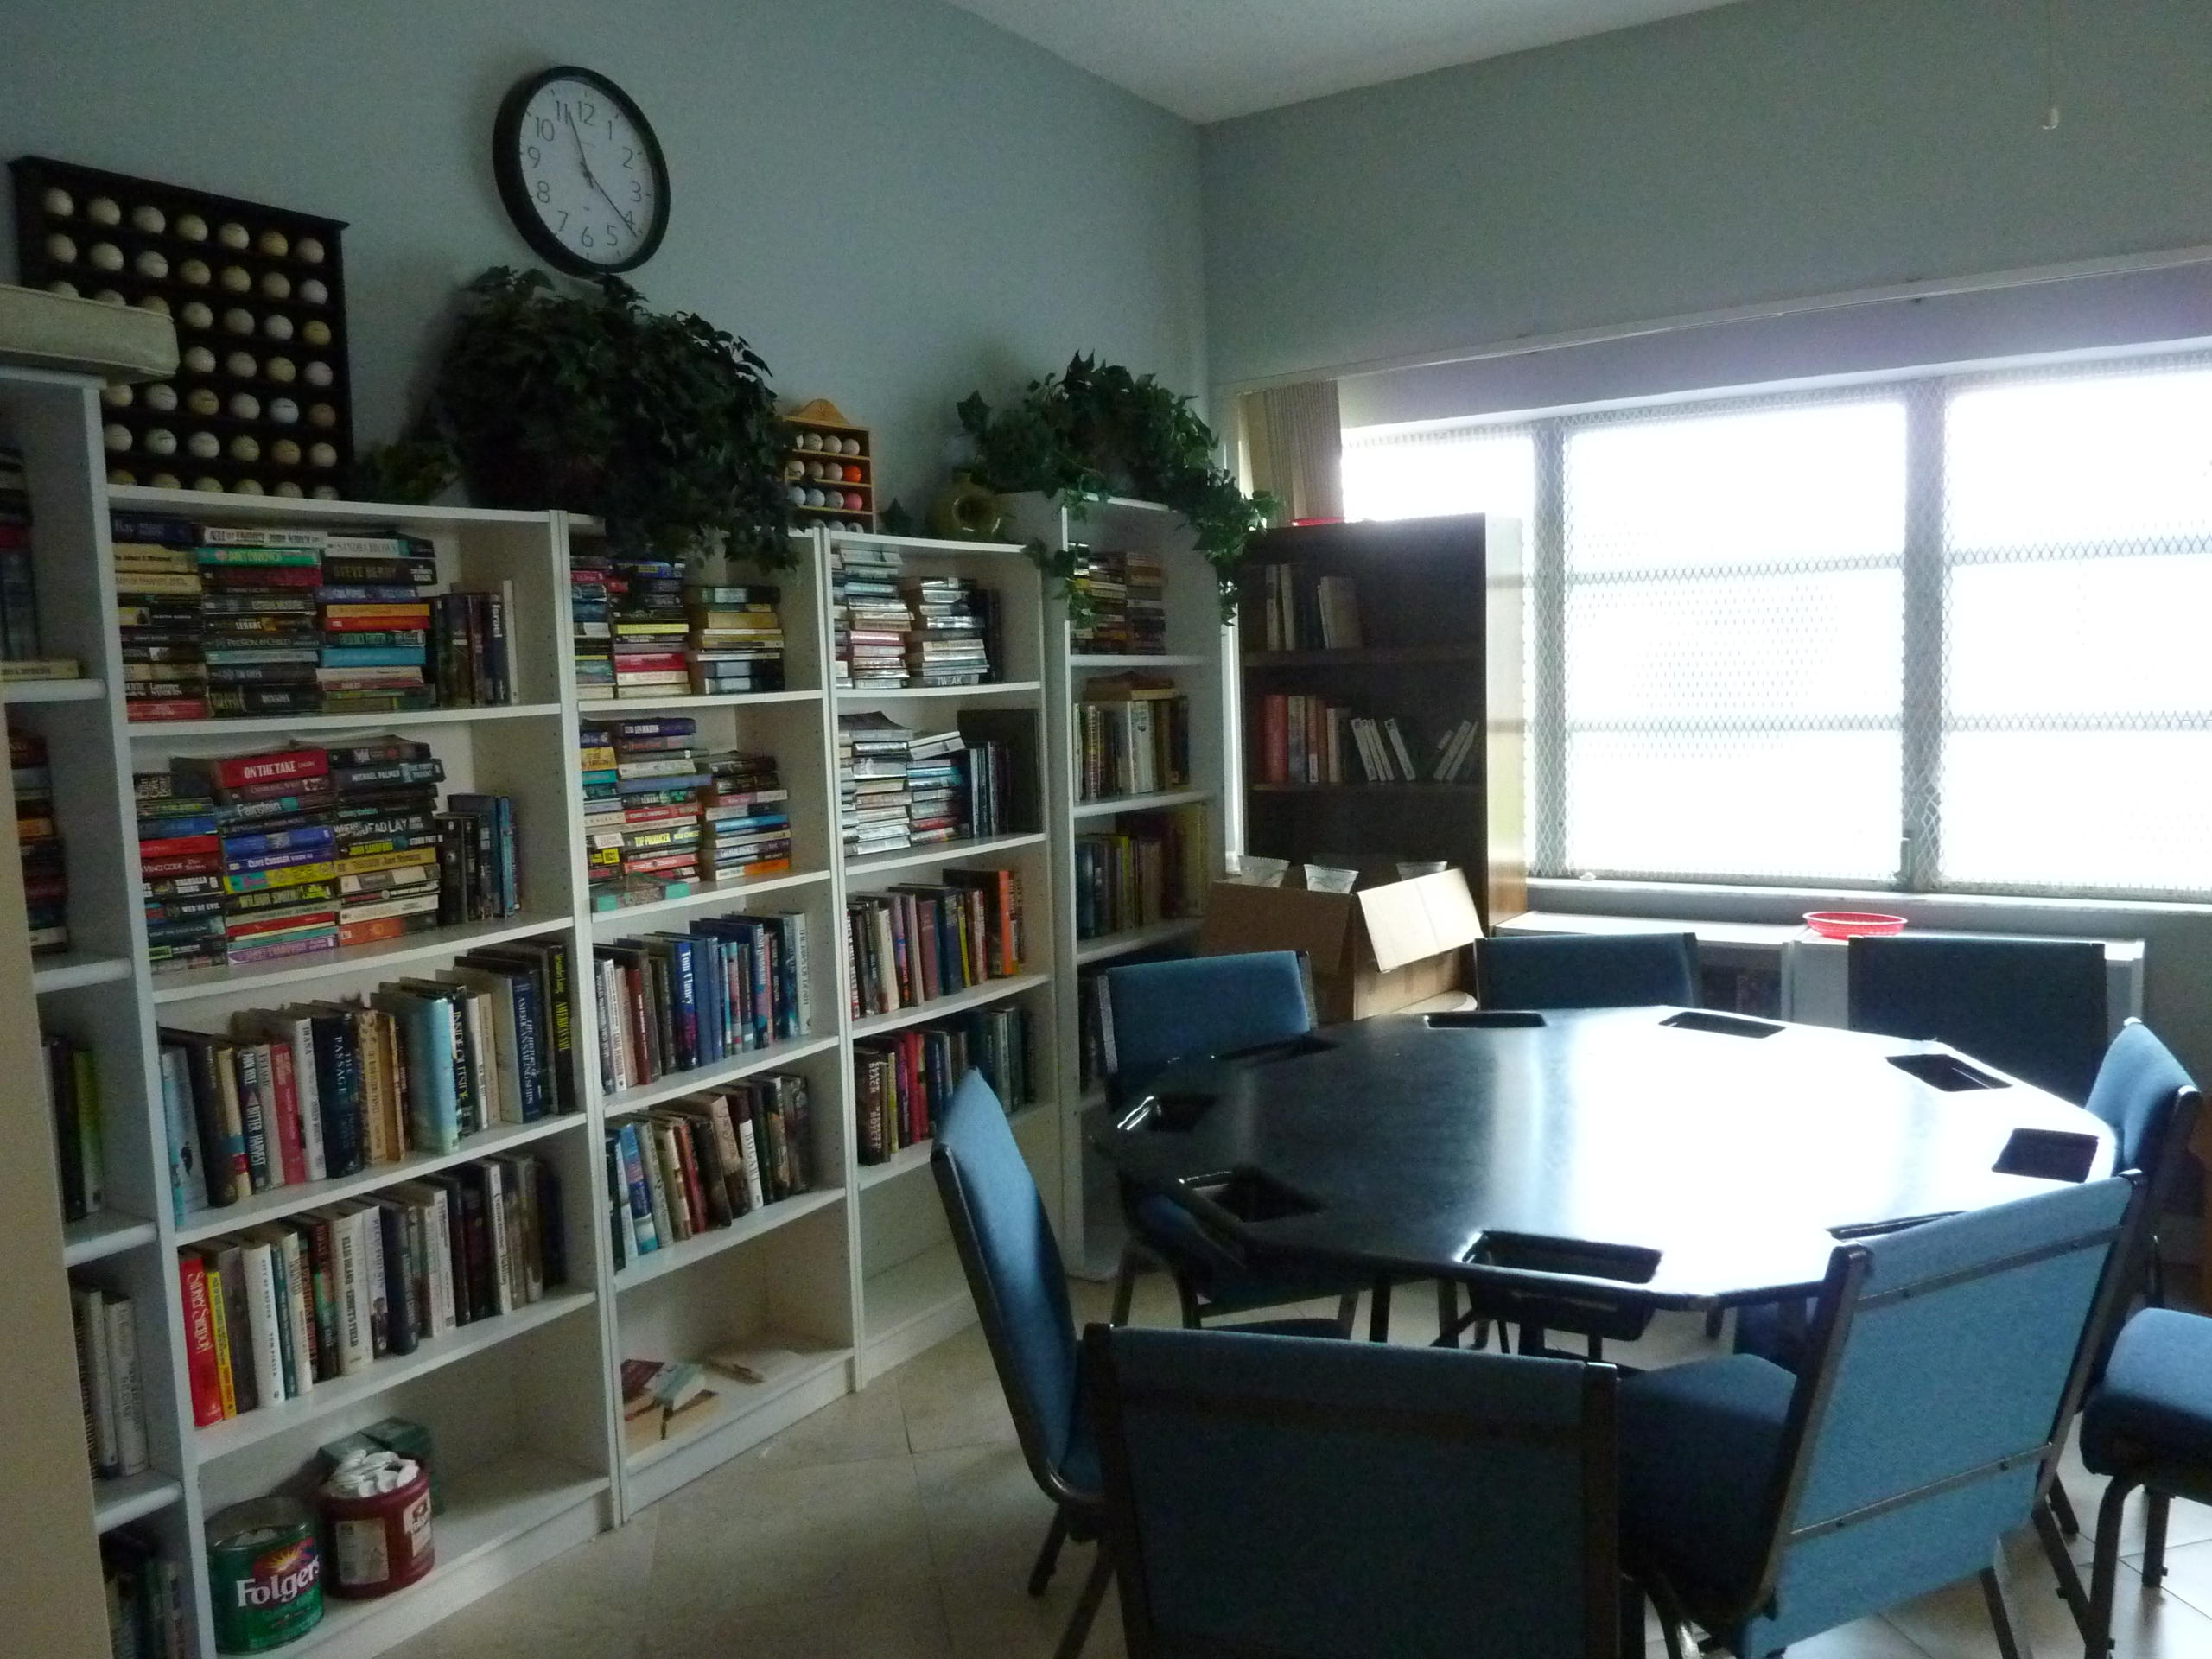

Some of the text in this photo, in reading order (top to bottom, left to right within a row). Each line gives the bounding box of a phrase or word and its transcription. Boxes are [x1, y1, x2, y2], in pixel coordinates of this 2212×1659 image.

[556, 100, 569, 125] 11
[577, 100, 595, 126] 12
[535, 117, 555, 142] 10
[528, 146, 541, 168] 9
[622, 146, 634, 169] 2
[537, 181, 550, 204] 8
[630, 181, 642, 203] 3
[558, 210, 569, 232] 7
[581, 226, 594, 248] 6
[607, 225, 619, 246] 5
[245, 761, 296, 779] ON THE TAKE
[352, 769, 401, 782] MICHAEL PALMER
[388, 818, 408, 833] LAY
[634, 836, 645, 847] TOP
[645, 833, 671, 845] PRODUCER
[164, 862, 183, 871] CODE
[248, 859, 264, 868] CLIVE
[264, 855, 290, 867] CUSSLER
[678, 949, 694, 1006] Tom Clancy
[556, 1001, 569, 1033] AMERICAN
[518, 996, 533, 1105] AMERICAN SAILING SHIPS
[245, 1052, 257, 1086] ANN RULE
[335, 1035, 346, 1094] PASSAGE
[248, 1104, 266, 1166] BITTER HARVEST
[746, 1132, 757, 1185] BOGART
[343, 1236, 352, 1259] ELLIS
[345, 1259, 354, 1286] ISLAND
[348, 1322, 359, 1349] FIELD
[236, 1556, 321, 1608] Folgers
